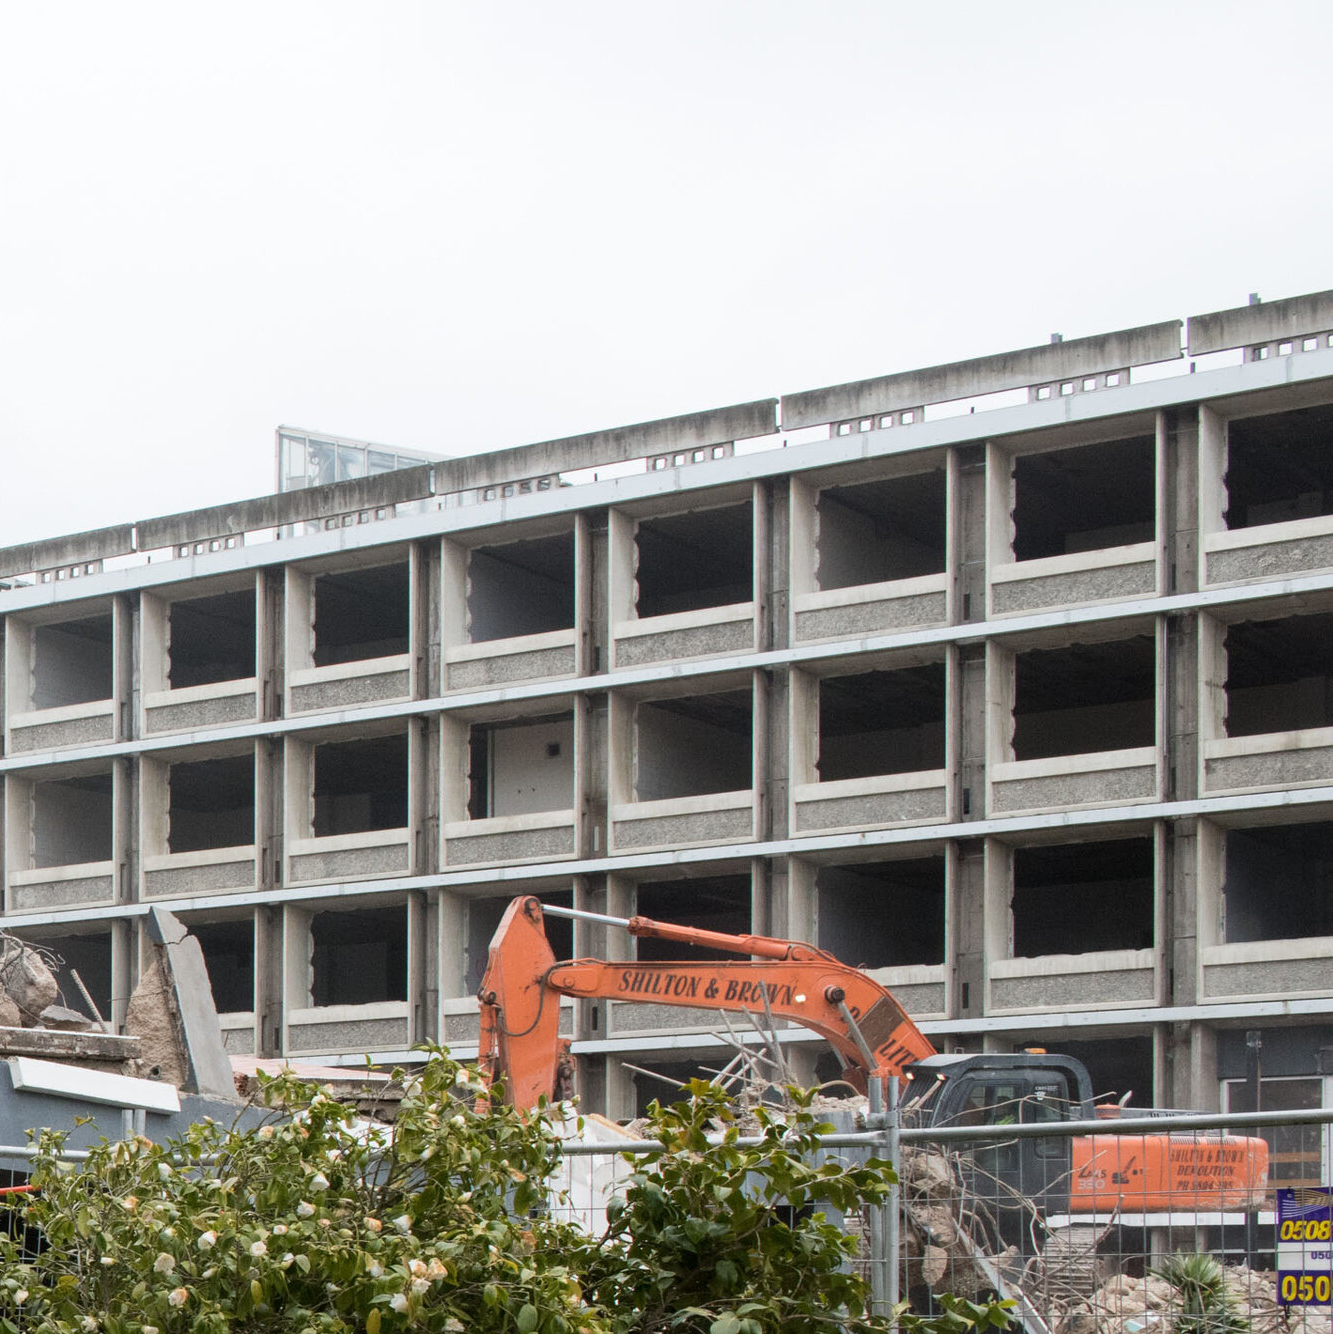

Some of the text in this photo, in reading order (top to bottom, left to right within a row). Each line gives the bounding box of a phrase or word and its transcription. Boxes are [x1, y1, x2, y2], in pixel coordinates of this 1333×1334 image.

[618, 969, 797, 1006] SHILTON & BROWN
[1177, 1165, 1235, 1177] DEMOLITION
[1282, 1275, 1332, 1302] 050
